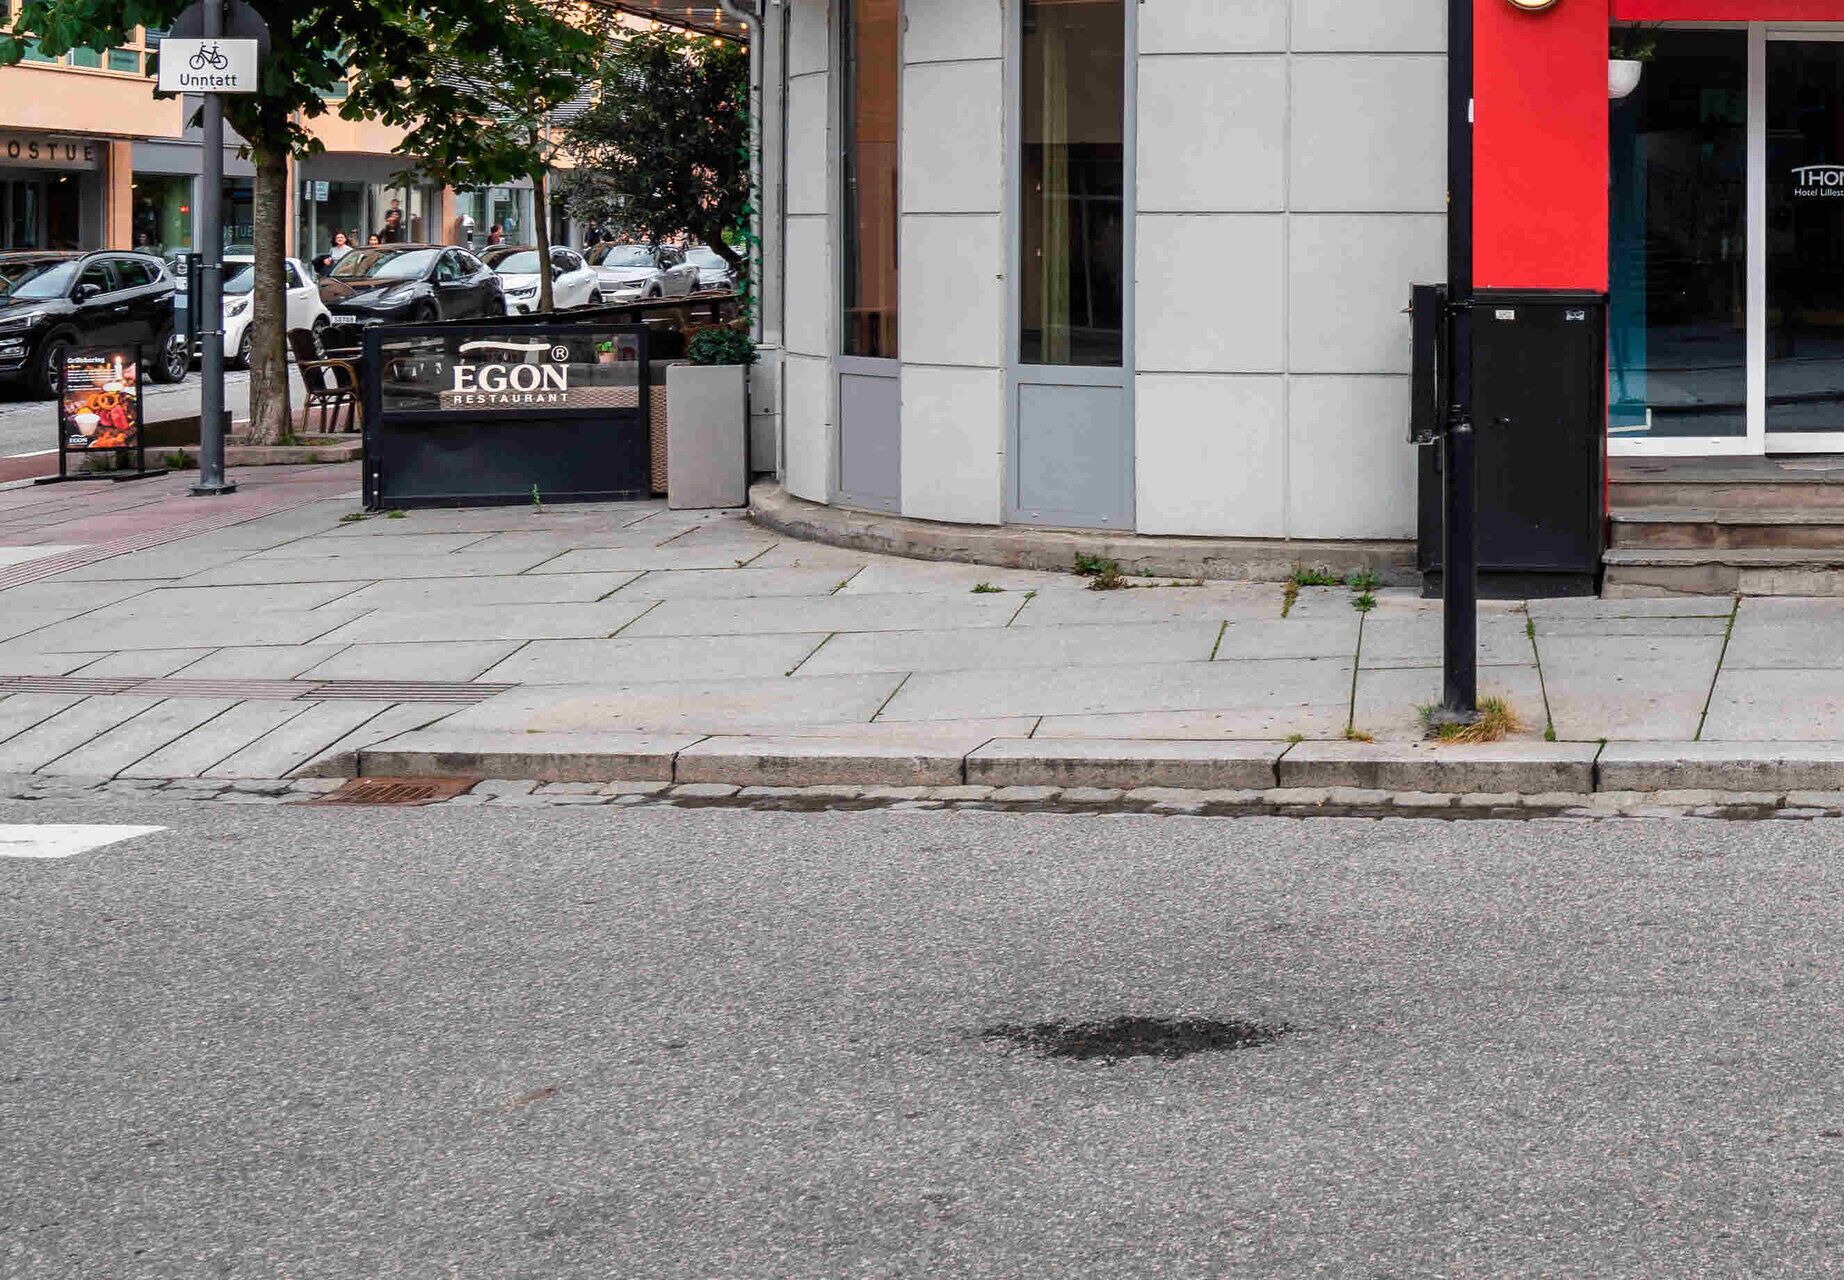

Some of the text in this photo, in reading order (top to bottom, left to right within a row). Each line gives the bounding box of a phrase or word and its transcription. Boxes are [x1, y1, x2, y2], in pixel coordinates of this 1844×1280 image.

[180, 73, 238, 87] Unntatt
[1794, 188, 1818, 197] Hotel
[452, 363, 570, 393] EGON
[453, 393, 568, 404] RESTAURANT
